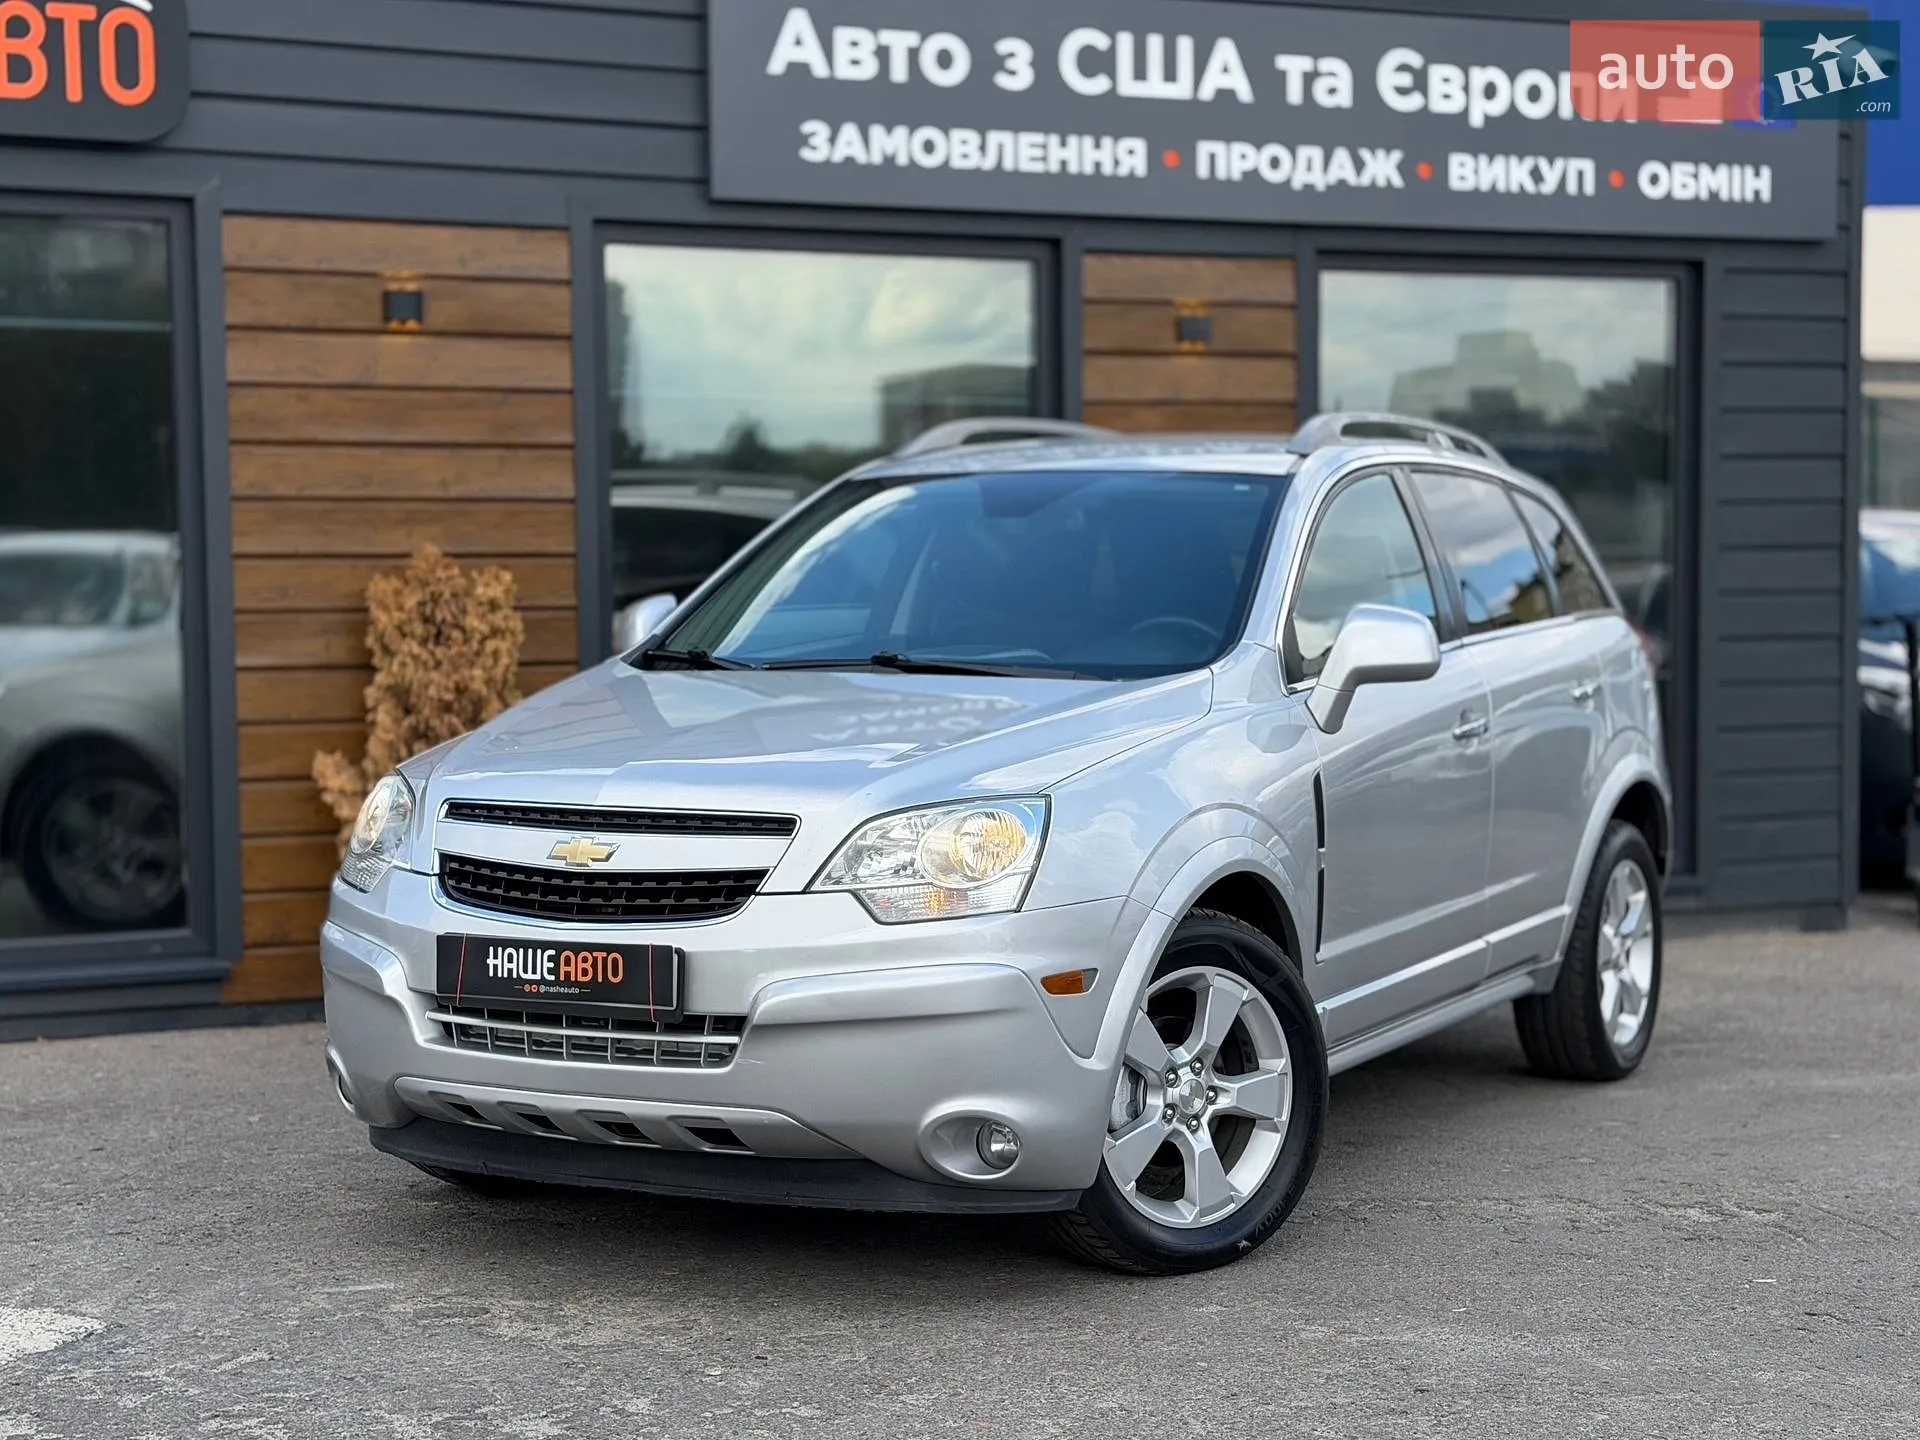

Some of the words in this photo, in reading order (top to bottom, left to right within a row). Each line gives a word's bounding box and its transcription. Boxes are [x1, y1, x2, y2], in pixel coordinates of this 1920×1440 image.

[766, 7, 971, 88] Авто
[993, 37, 1035, 92] з
[1058, 27, 1254, 104] США
[1275, 54, 1354, 109] та
[1376, 47, 1638, 129] Європи
[799, 119, 1148, 178] ЗАМОВЛЕННЯ
[1195, 139, 1405, 192] ПРОДАЖ
[1447, 152, 1596, 197] ВИКУП
[1637, 160, 1772, 203] ОБМІН
[487, 946, 556, 980] НАШЕ
[559, 950, 624, 984] АВТО
